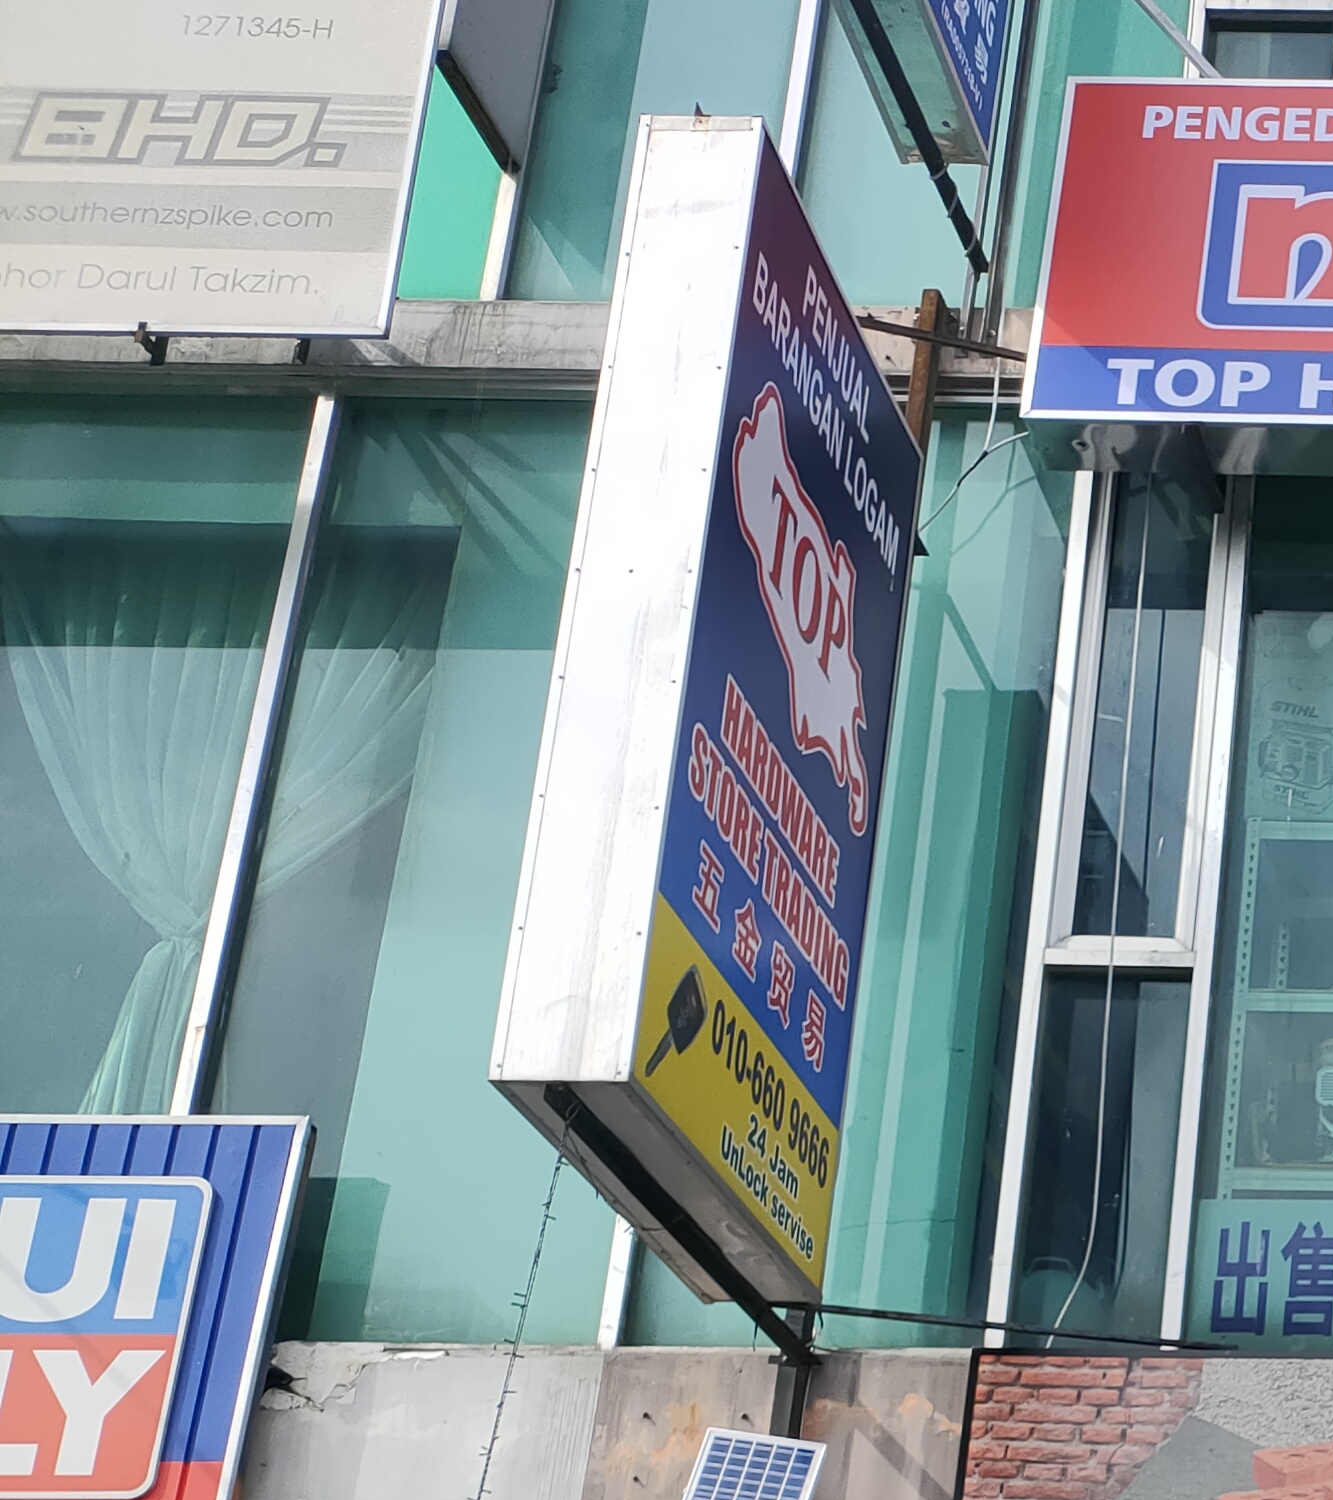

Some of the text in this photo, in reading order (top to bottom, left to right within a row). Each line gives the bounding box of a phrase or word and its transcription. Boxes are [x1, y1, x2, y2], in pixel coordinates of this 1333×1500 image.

[180, 14, 334, 40] 1271345-H
[12, 91, 347, 167] BHD.
[0, 263, 320, 295] hor Darul Takzim.
[753, 250, 846, 471] BARANGAN
[802, 264, 870, 445] PENJUAL
[1107, 358, 1272, 408] TOP
[768, 475, 847, 684] TOP
[1271, 700, 1320, 719] STIHL
[720, 673, 840, 910] HARDWARE
[688, 722, 851, 1012] STORE TRADING
[692, 839, 827, 1073] 五金贸易
[711, 1000, 831, 1189] 010-660 9666
[747, 1113, 799, 1200] 24 Jam
[771, 1192, 815, 1261] servise
